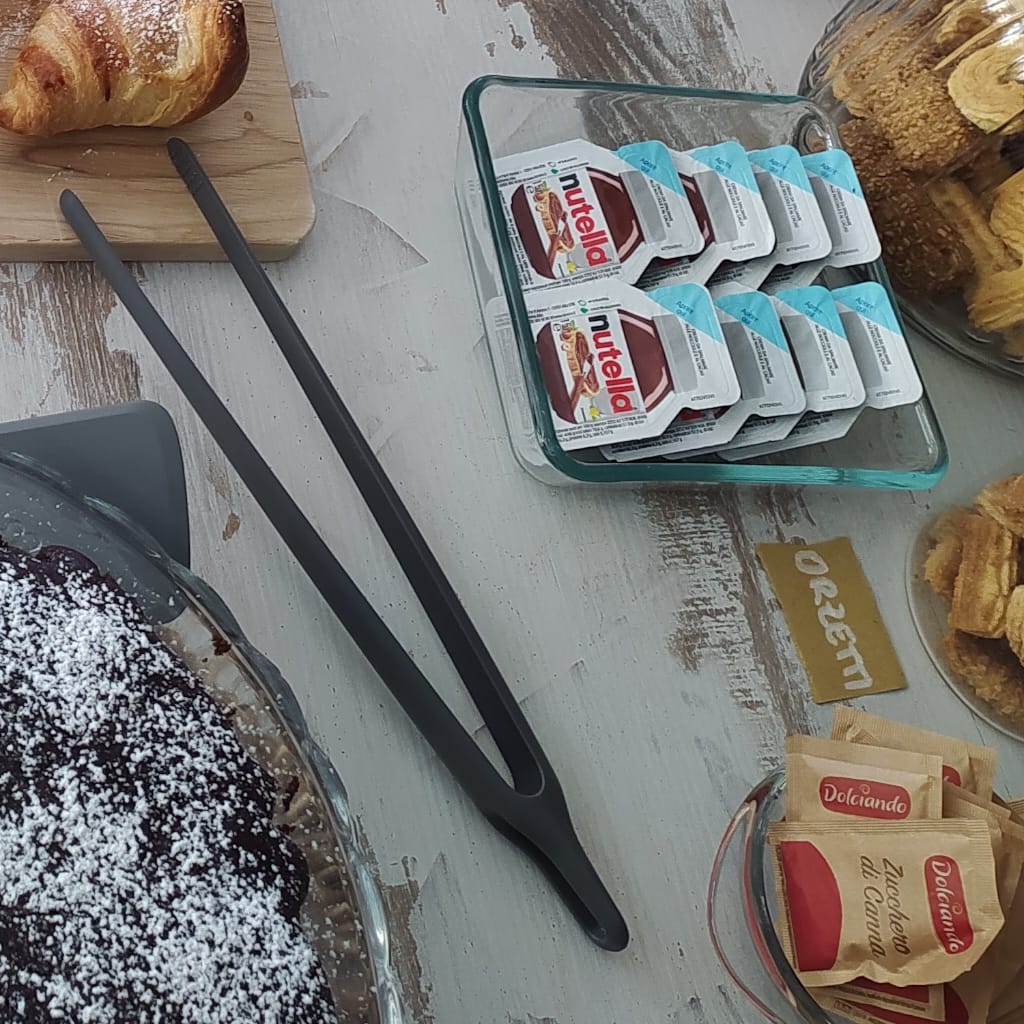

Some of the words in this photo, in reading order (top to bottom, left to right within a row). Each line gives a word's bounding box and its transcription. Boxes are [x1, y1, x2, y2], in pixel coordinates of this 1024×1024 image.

[558, 173, 610, 267] nutella
[588, 314, 636, 414] nutella
[823, 784, 907, 814] Dolciando
[860, 855, 881, 879] di
[882, 857, 911, 955] Zucchero
[931, 860, 965, 953] Dolciando
[863, 886, 887, 958] Canna
